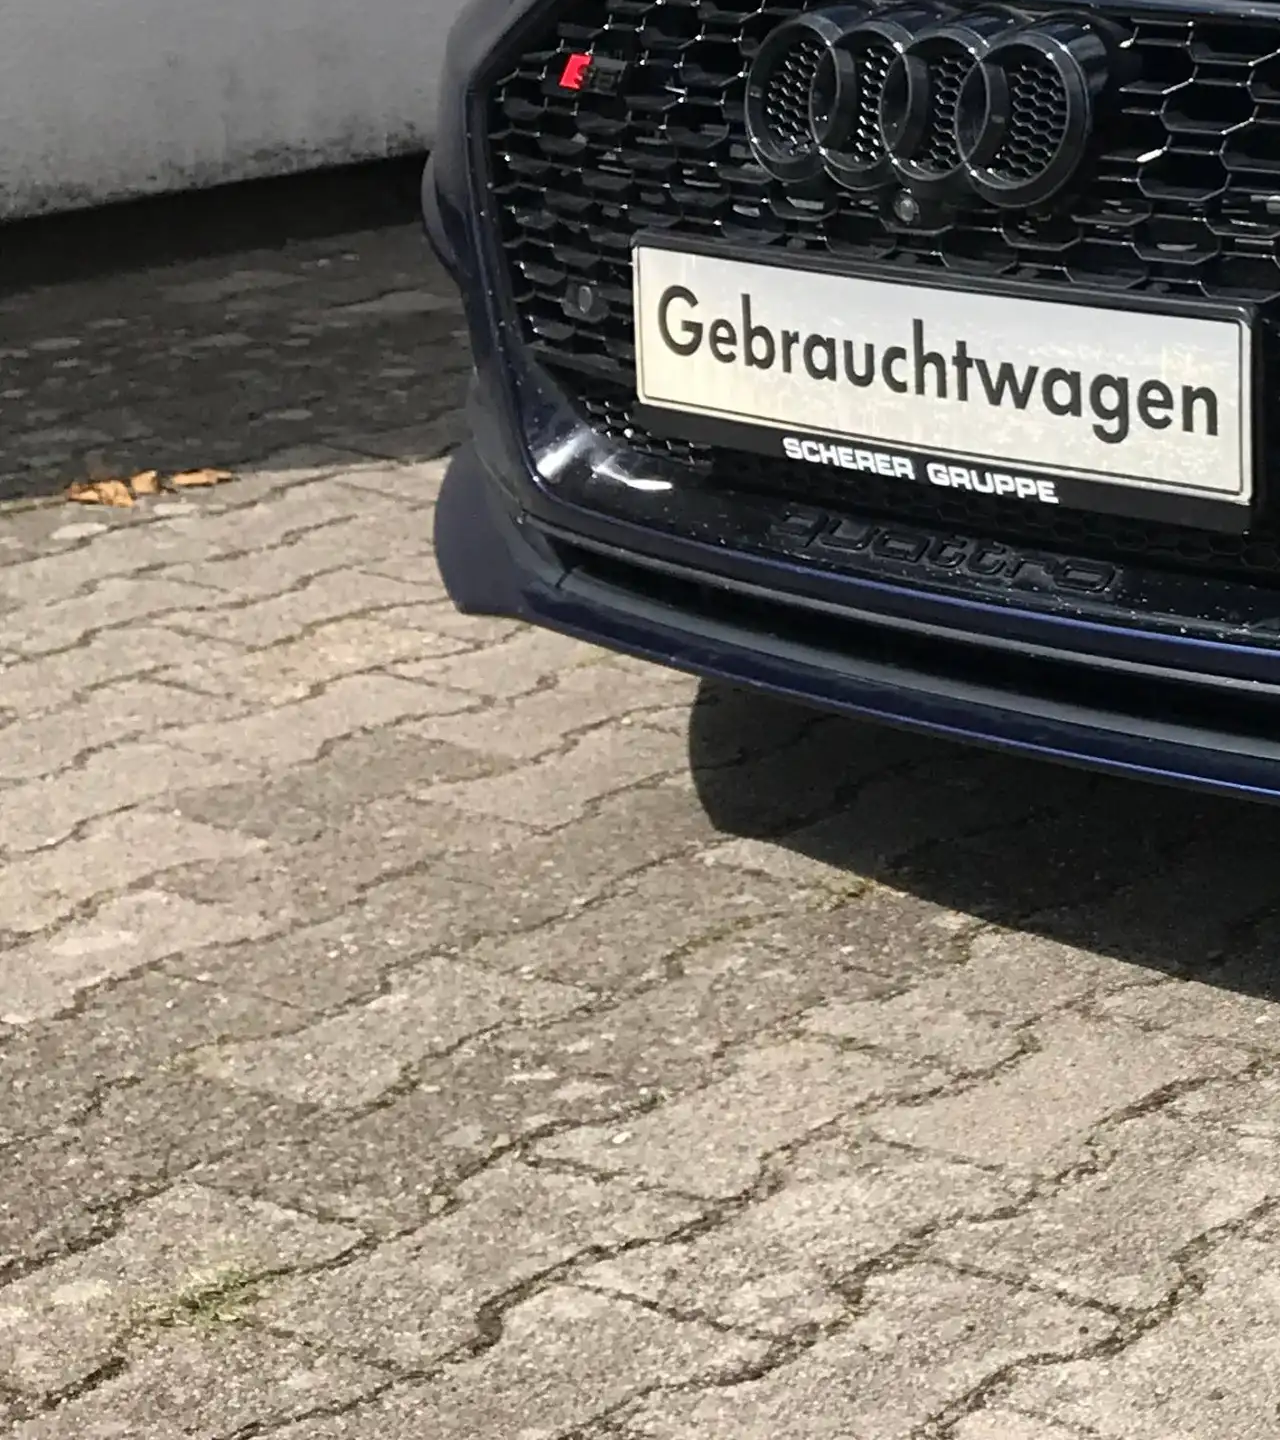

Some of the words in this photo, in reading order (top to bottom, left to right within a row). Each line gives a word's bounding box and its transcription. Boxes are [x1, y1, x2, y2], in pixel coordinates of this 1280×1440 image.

[656, 285, 1219, 444] Gebrauchtwagen
[782, 437, 916, 481] SCHERER
[926, 462, 1060, 505] GRUPPE
[771, 505, 1119, 594] quattro
